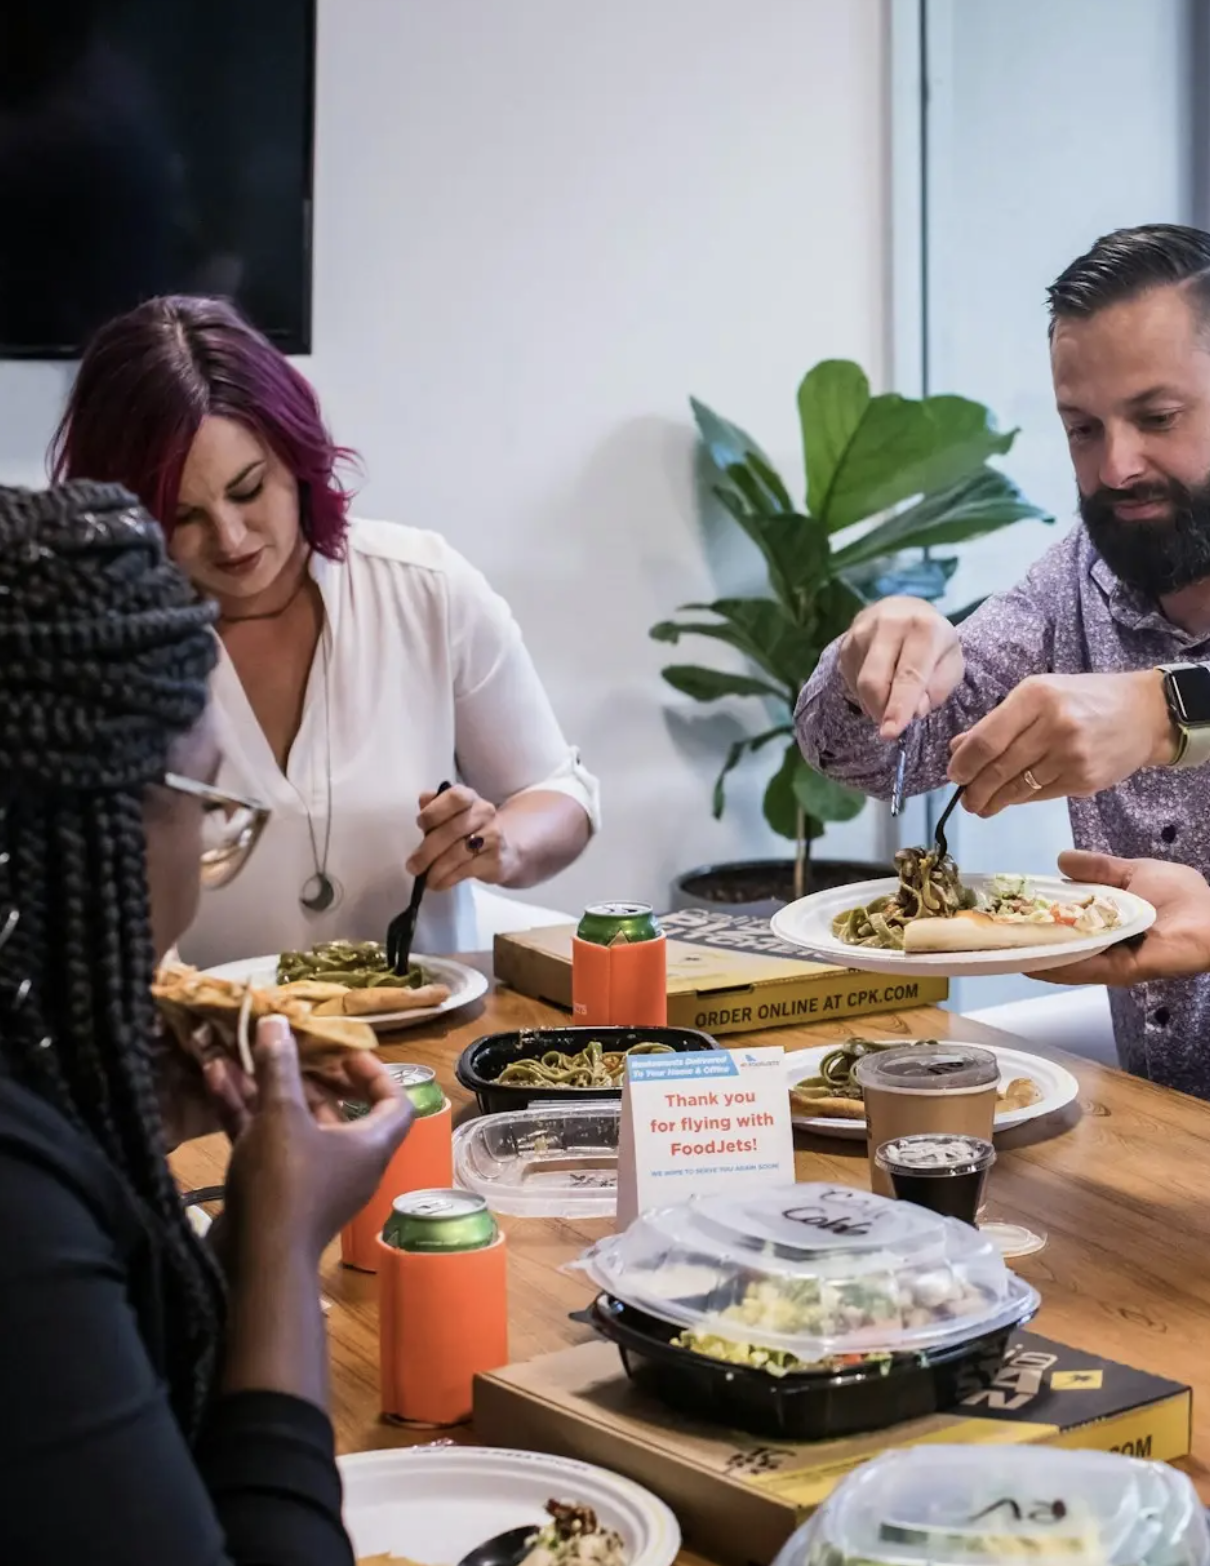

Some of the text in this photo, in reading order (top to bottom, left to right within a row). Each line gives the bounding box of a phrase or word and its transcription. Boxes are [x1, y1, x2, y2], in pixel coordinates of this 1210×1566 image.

[695, 983, 918, 1028] ORDER ONLINE AT CPK.COM
[685, 1056, 728, 1066] Delivered
[633, 1065, 730, 1078] To Your Home & Office
[665, 1092, 756, 1107] Thank you
[650, 1112, 774, 1133] for flying with
[670, 1138, 757, 1156] FoodJets!
[695, 1167, 717, 1175] SERVE
[735, 1164, 756, 1172] AGAIN
